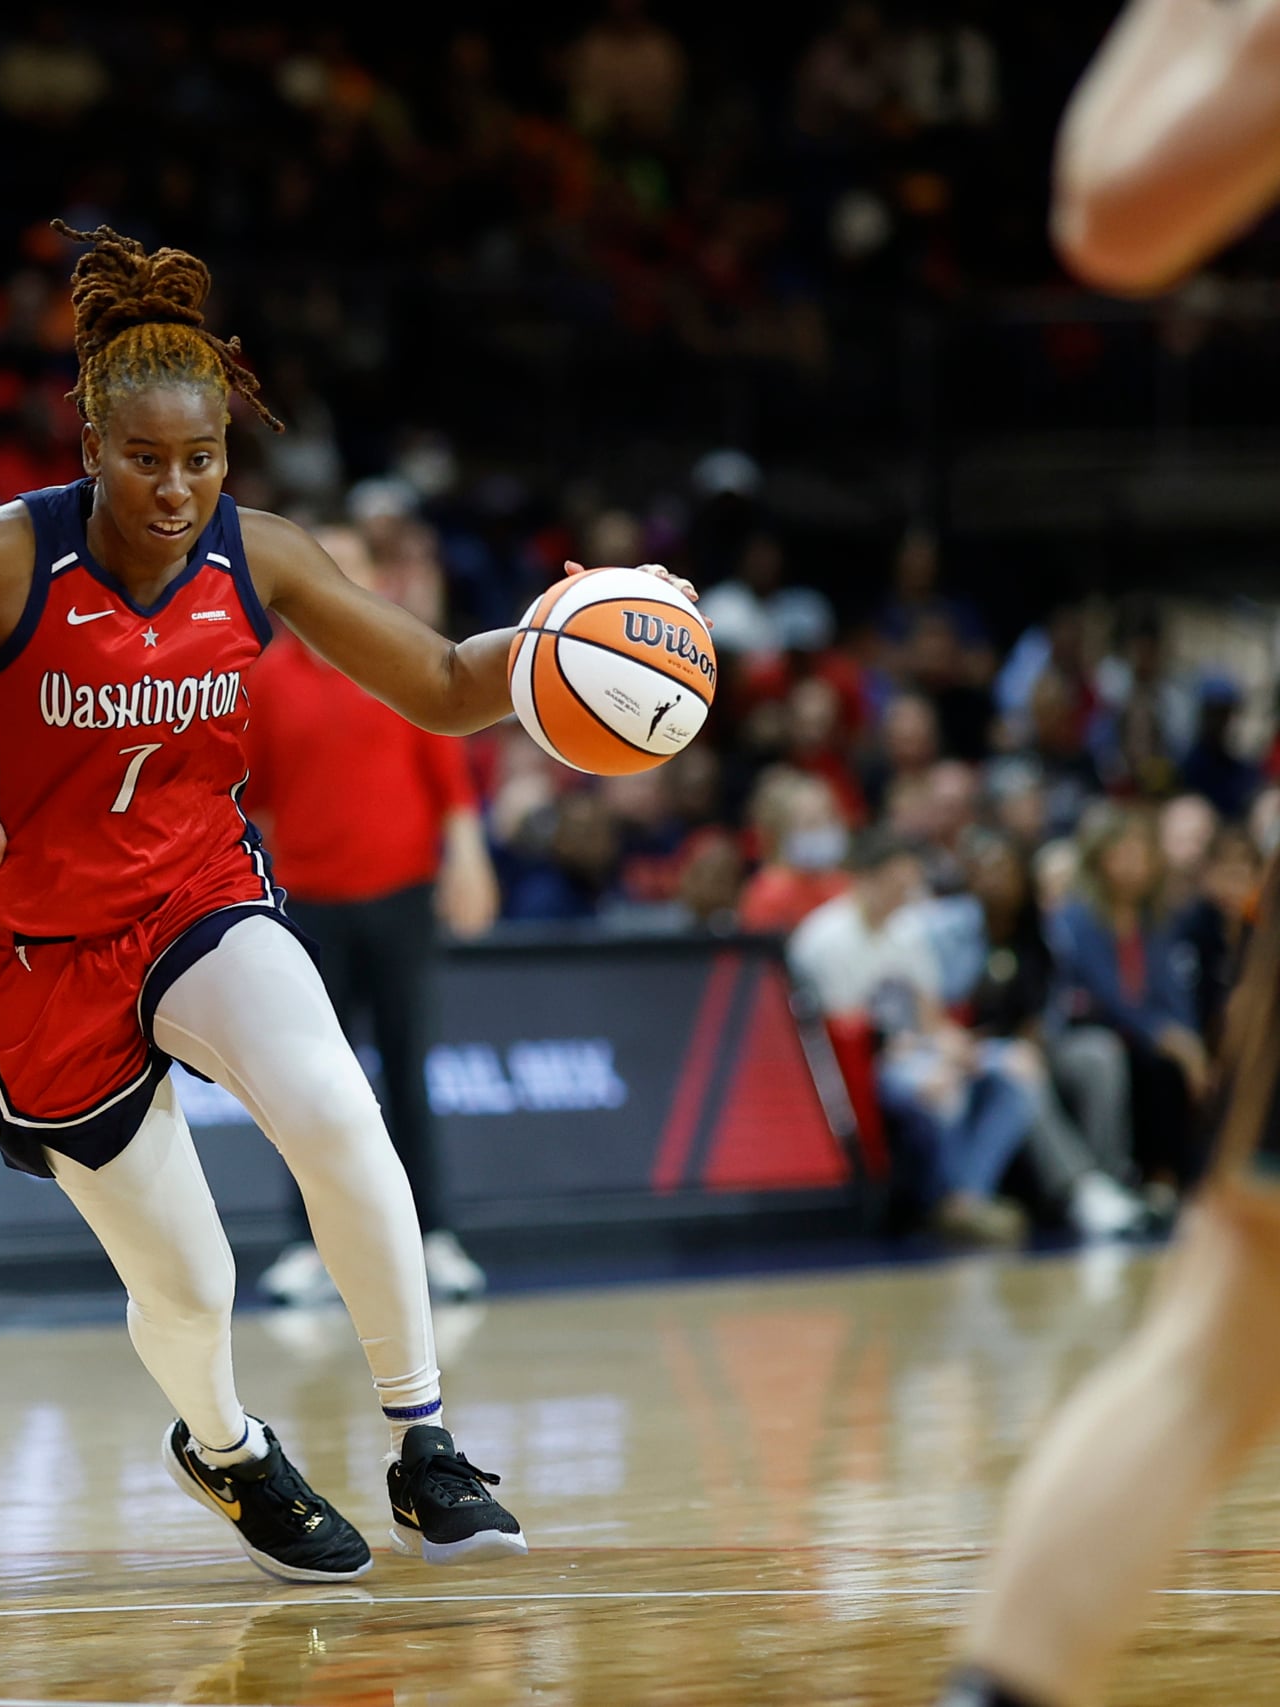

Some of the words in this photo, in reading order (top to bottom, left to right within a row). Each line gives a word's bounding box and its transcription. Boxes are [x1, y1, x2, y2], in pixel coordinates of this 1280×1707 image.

[621, 609, 715, 690] Wilson
[39, 670, 241, 734] Washington
[110, 742, 163, 813] 7
